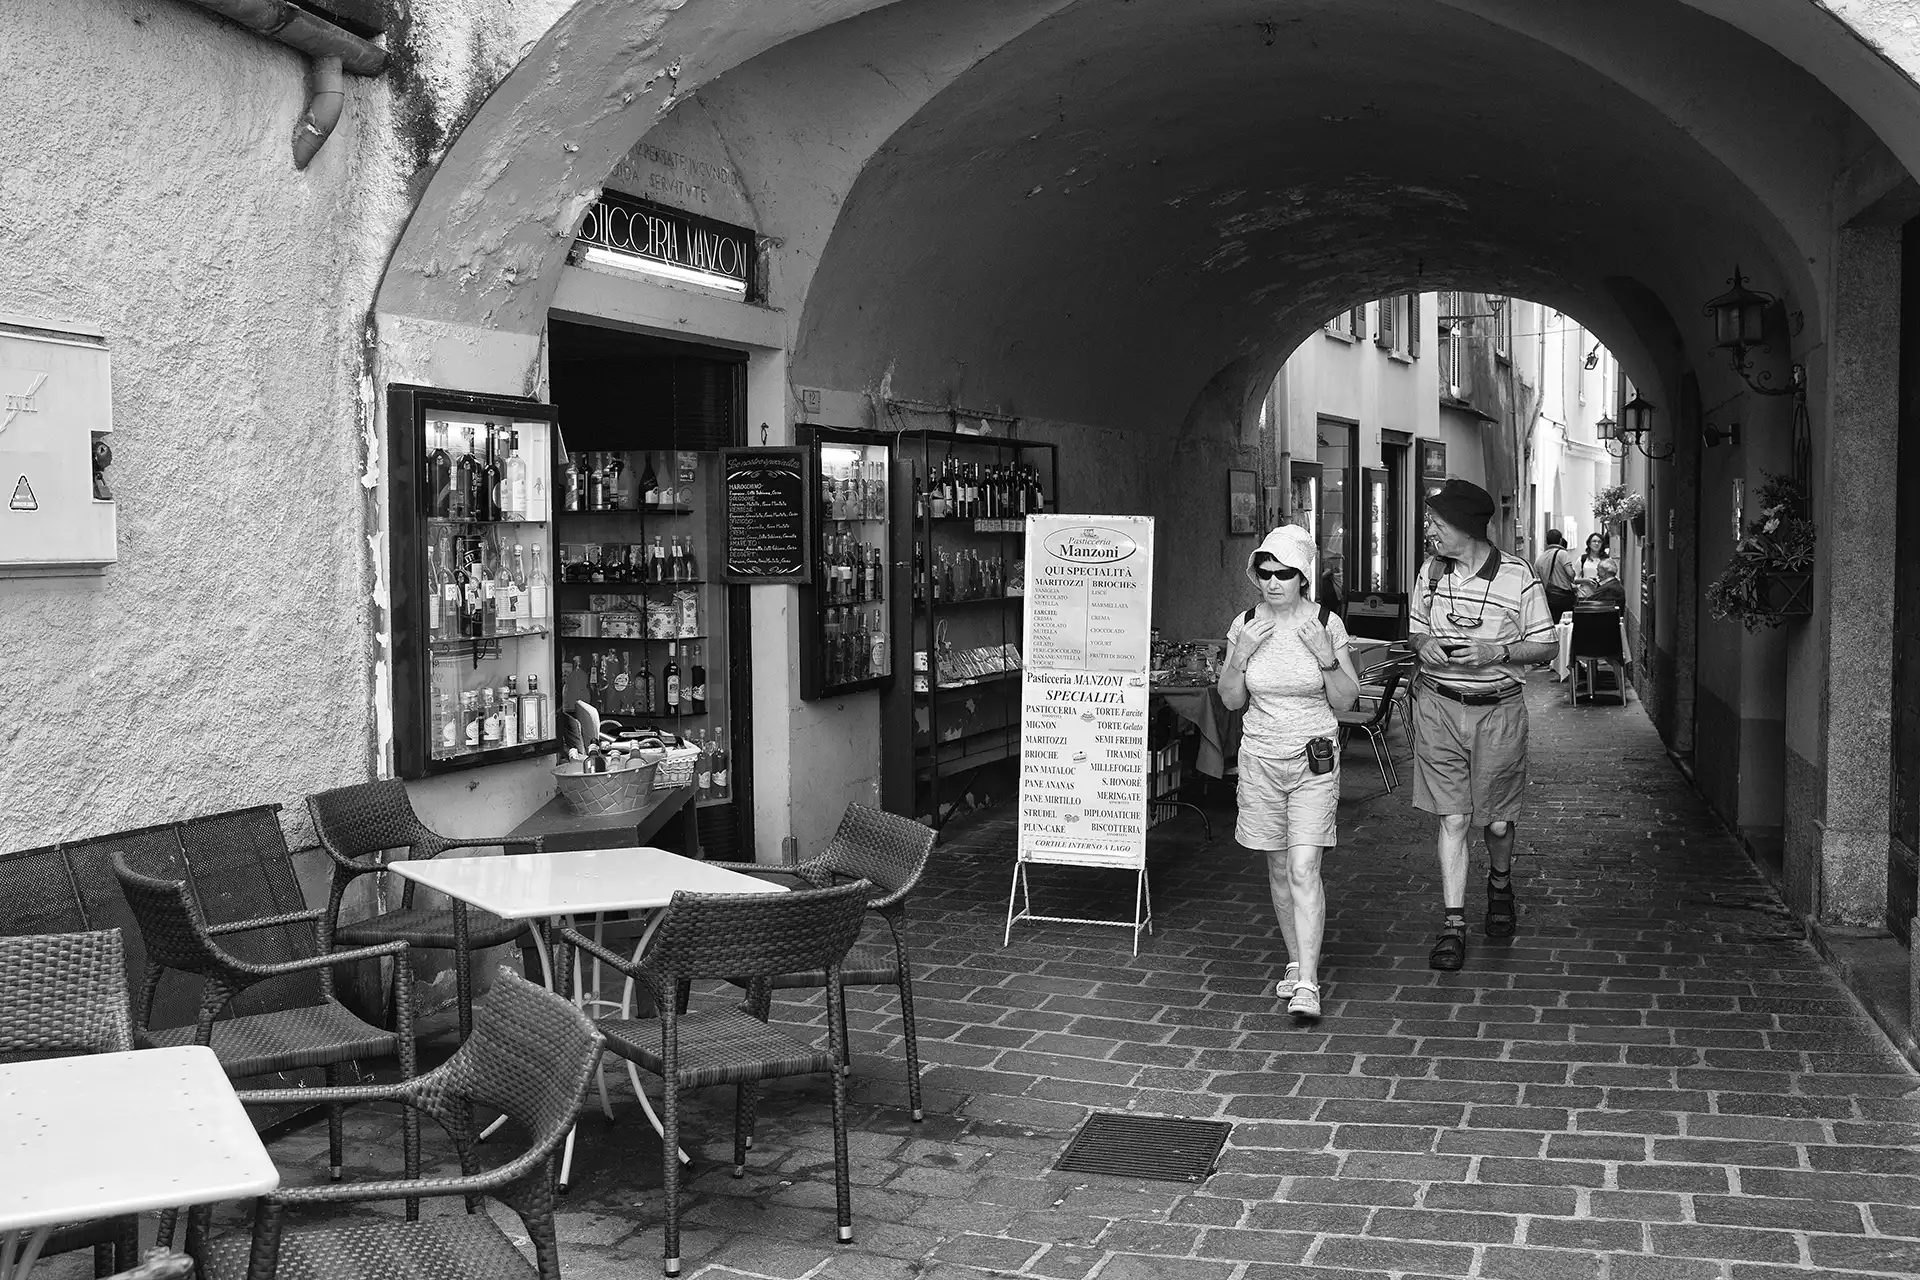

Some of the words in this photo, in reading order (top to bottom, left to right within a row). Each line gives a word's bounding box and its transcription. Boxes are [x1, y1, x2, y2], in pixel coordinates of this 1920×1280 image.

[6, 394, 38, 413] ENEL
[809, 392, 816, 405] 12
[1068, 537, 1111, 546] Pasticceria
[1060, 545, 1118, 558] Manzoni
[1045, 566, 1065, 575] QUI
[1067, 566, 1132, 577] SPECIALITÀ
[1035, 578, 1083, 587] MARITOZZI
[1092, 581, 1136, 589] BRIOCHES
[1027, 672, 1071, 684] Pasticceria
[1074, 675, 1123, 687] MANZONI
[1046, 690, 1124, 703] SPECIALITÀ
[1026, 705, 1077, 715] PASTICCERIA
[1095, 708, 1120, 716] TORTE
[1121, 708, 1143, 717] Farcite
[1025, 721, 1056, 729] MIGNON
[1097, 722, 1122, 730] TORTE
[1123, 723, 1143, 731] Gelato
[1025, 736, 1067, 745] MARITOZZI
[1115, 737, 1143, 745] FREDDI
[1025, 750, 1058, 759] BRIOCHE
[1106, 748, 1142, 759] TIRAMISÙ
[1025, 765, 1040, 773] PAN
[1041, 766, 1076, 775] MATALOC
[1090, 763, 1142, 773] MILLEFOGLIE
[1025, 780, 1044, 788] PANE
[1045, 781, 1074, 790] ANANAS
[1102, 778, 1108, 786] S.
[1024, 794, 1043, 803] PANE
[1045, 795, 1081, 805] MIRTILLO
[1097, 791, 1141, 801] MERINGATE
[1024, 809, 1057, 818] STRUDEL
[1084, 810, 1141, 819] DIPLOMATICHE
[1024, 823, 1066, 833] PLUN-CAKE
[1091, 824, 1141, 834] BISCOTTERIA
[1035, 839, 1066, 848] CORTILE
[1068, 842, 1102, 850] INTERNO
[1110, 844, 1131, 852] LAGO
